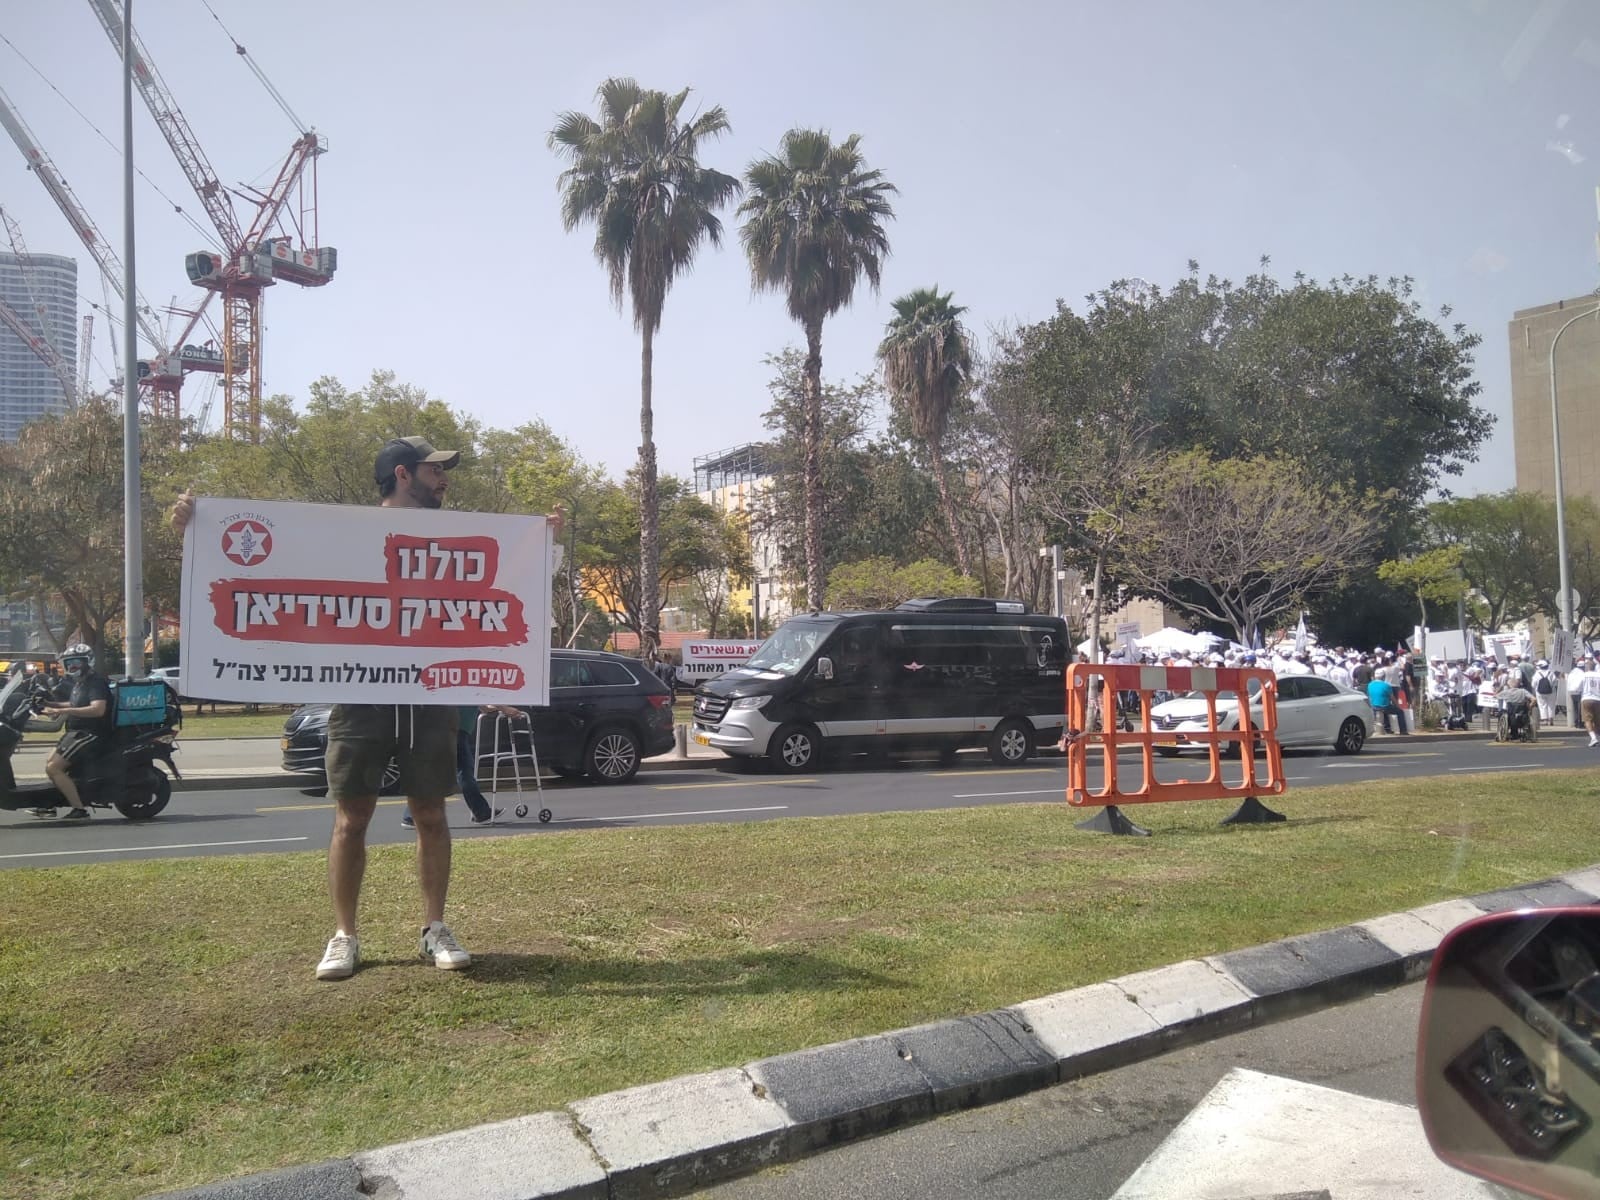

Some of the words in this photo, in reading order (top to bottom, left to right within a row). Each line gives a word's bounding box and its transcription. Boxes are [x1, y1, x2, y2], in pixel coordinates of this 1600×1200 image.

[397, 541, 486, 582] כולנו
[232, 591, 392, 634] סעידיאן
[399, 598, 509, 637] איציק
[689, 645, 745, 655] משאירים
[273, 664, 314, 682] בנכי
[319, 662, 423, 684] להתעללות
[428, 667, 462, 688] סוף
[467, 668, 519, 685] שמים
[684, 663, 725, 673] מאחור
